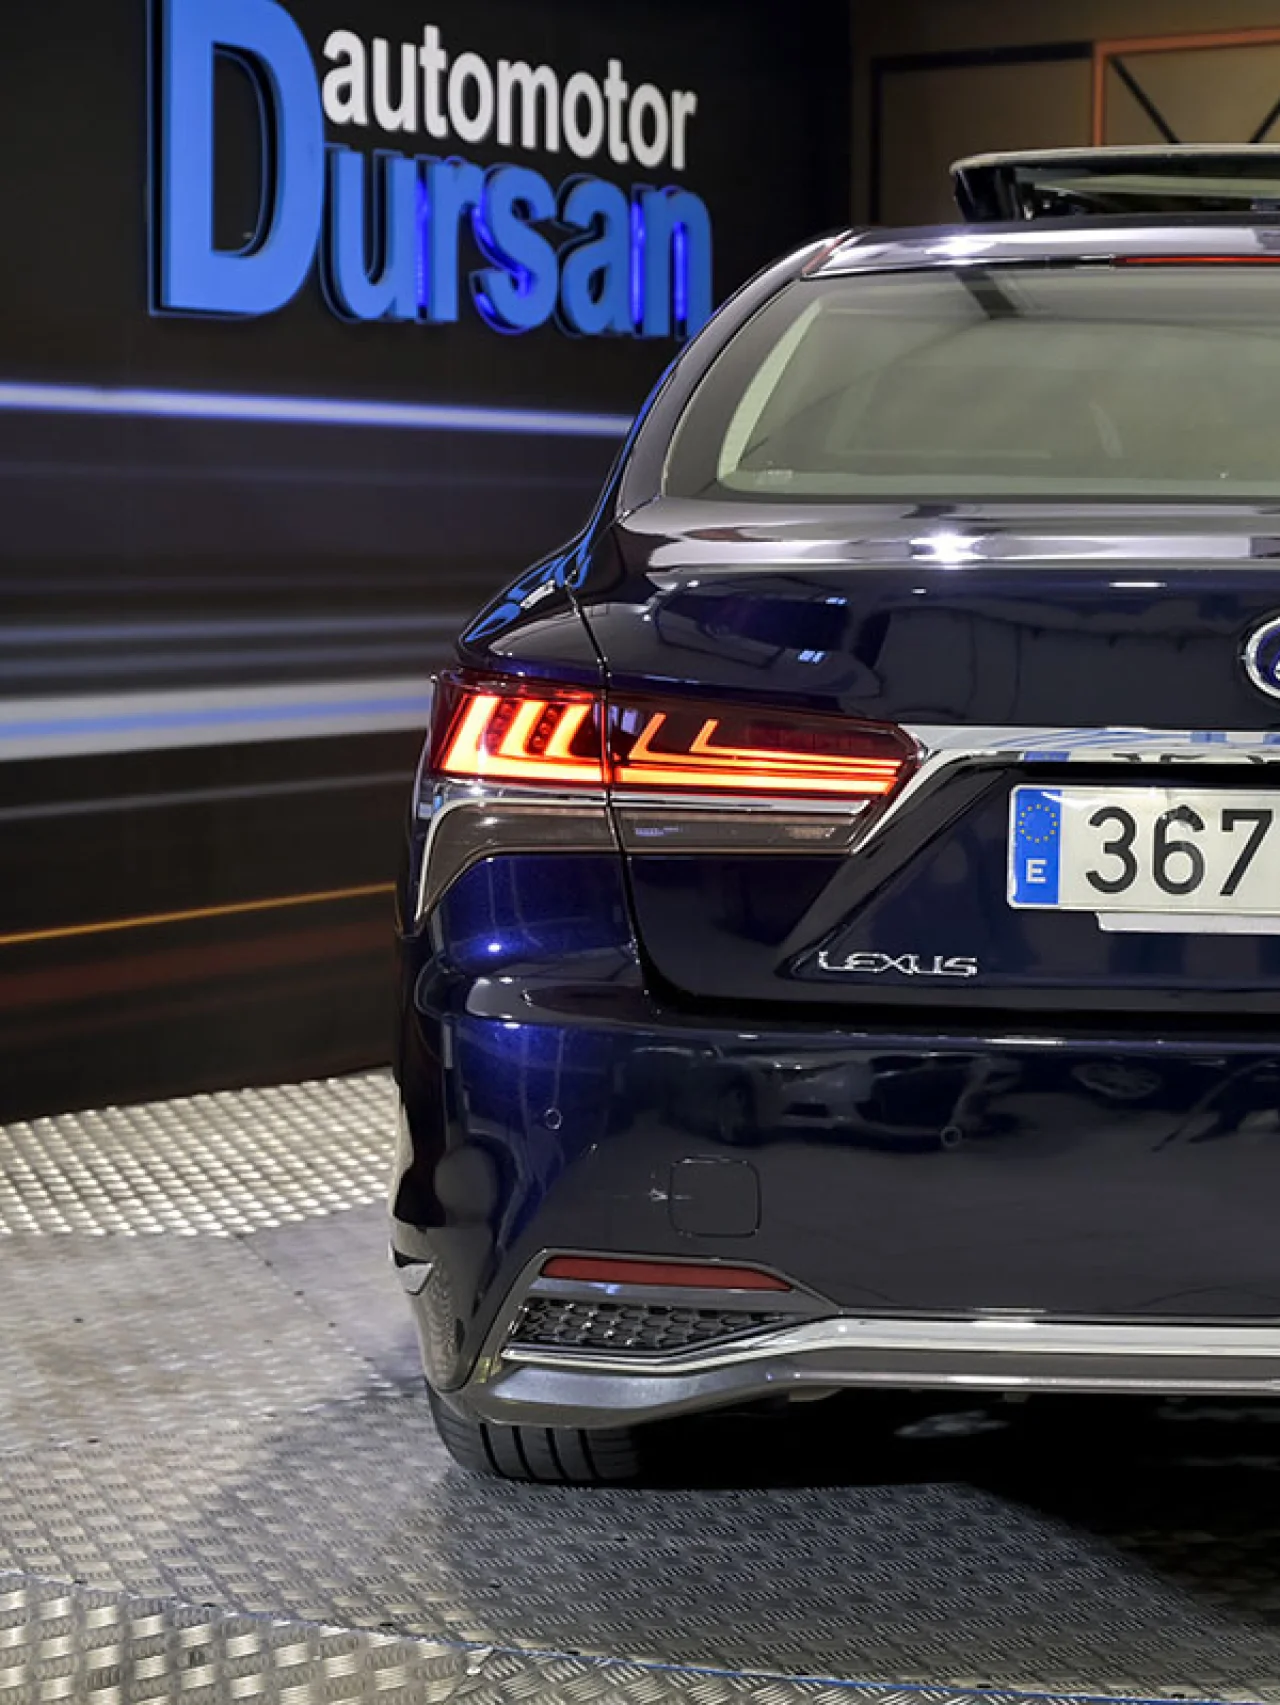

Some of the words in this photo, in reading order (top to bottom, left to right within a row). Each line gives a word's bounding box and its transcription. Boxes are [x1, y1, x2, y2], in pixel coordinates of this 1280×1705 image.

[321, 24, 697, 171] automotor
[148, 0, 713, 340] Dursan
[1026, 859, 1048, 884] E
[818, 951, 978, 977] LEXUS
